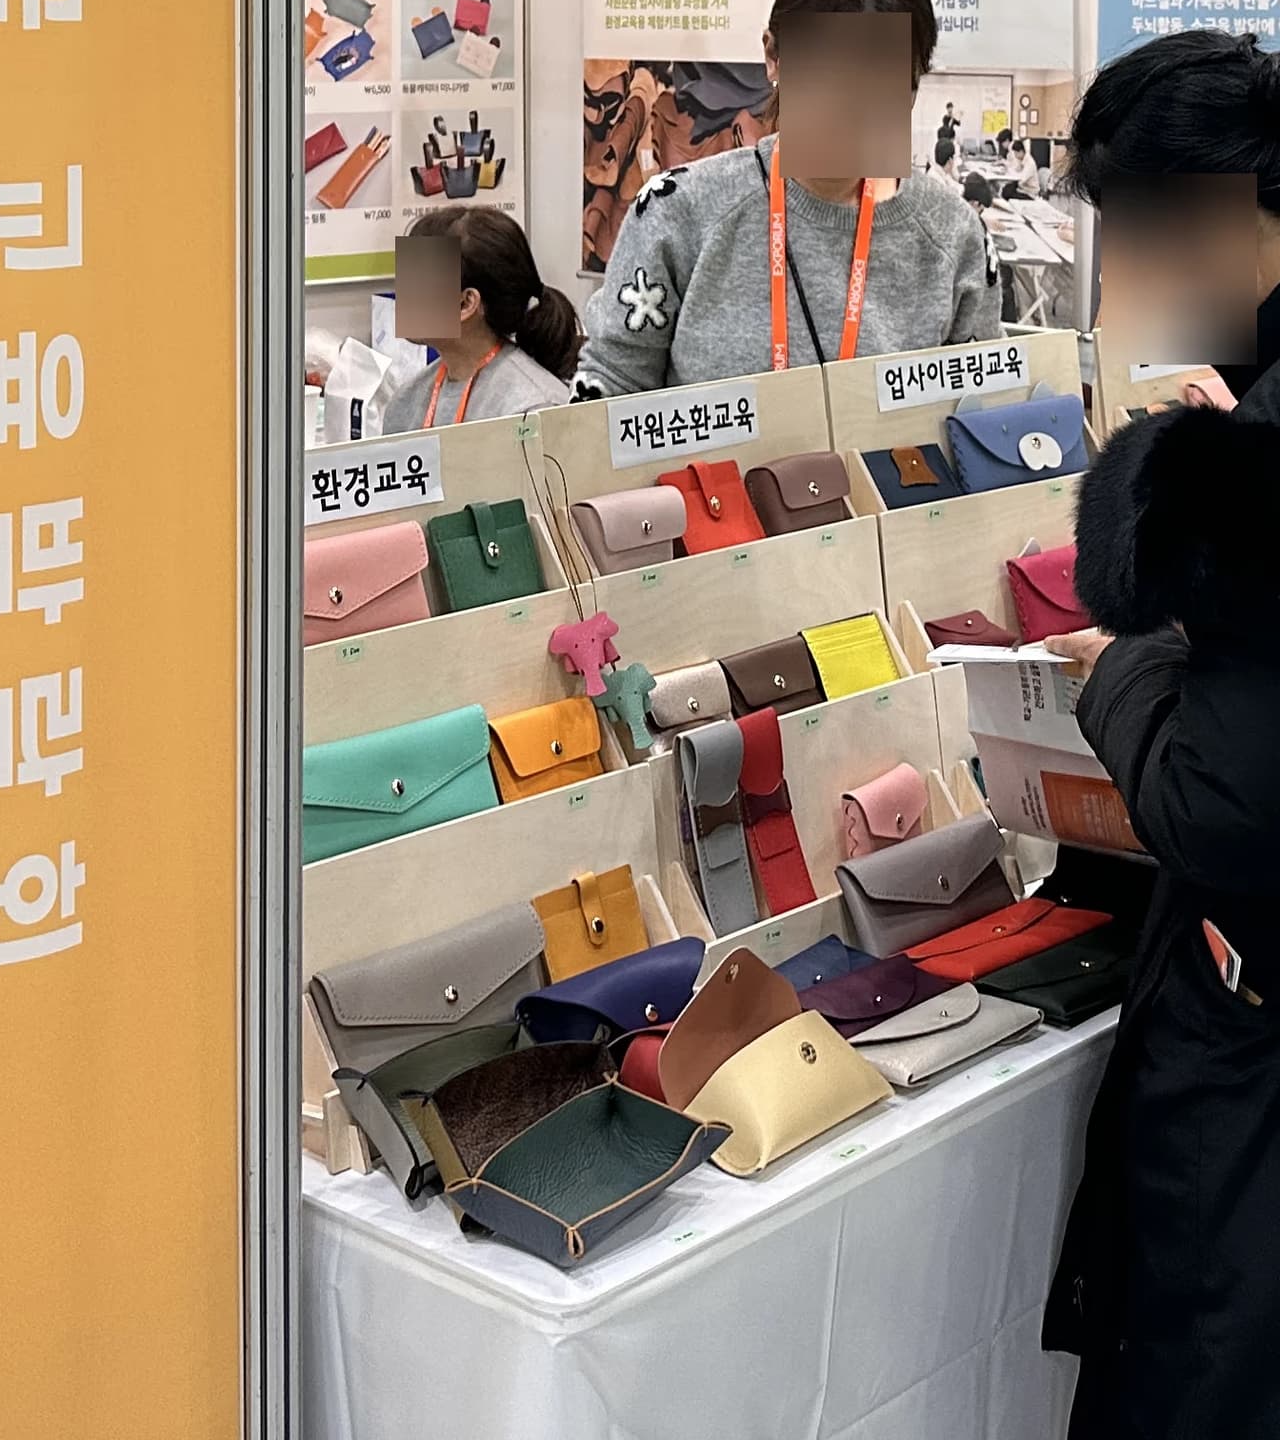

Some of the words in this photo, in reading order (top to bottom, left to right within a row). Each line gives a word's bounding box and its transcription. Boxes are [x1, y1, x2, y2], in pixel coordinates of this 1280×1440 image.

[772, 213, 784, 276] EXPORUM
[847, 260, 865, 322] EXPORUM
[883, 343, 1024, 402] 업사이클링교육
[619, 395, 756, 450] 자원순환교육
[312, 453, 431, 514] 환경교육
